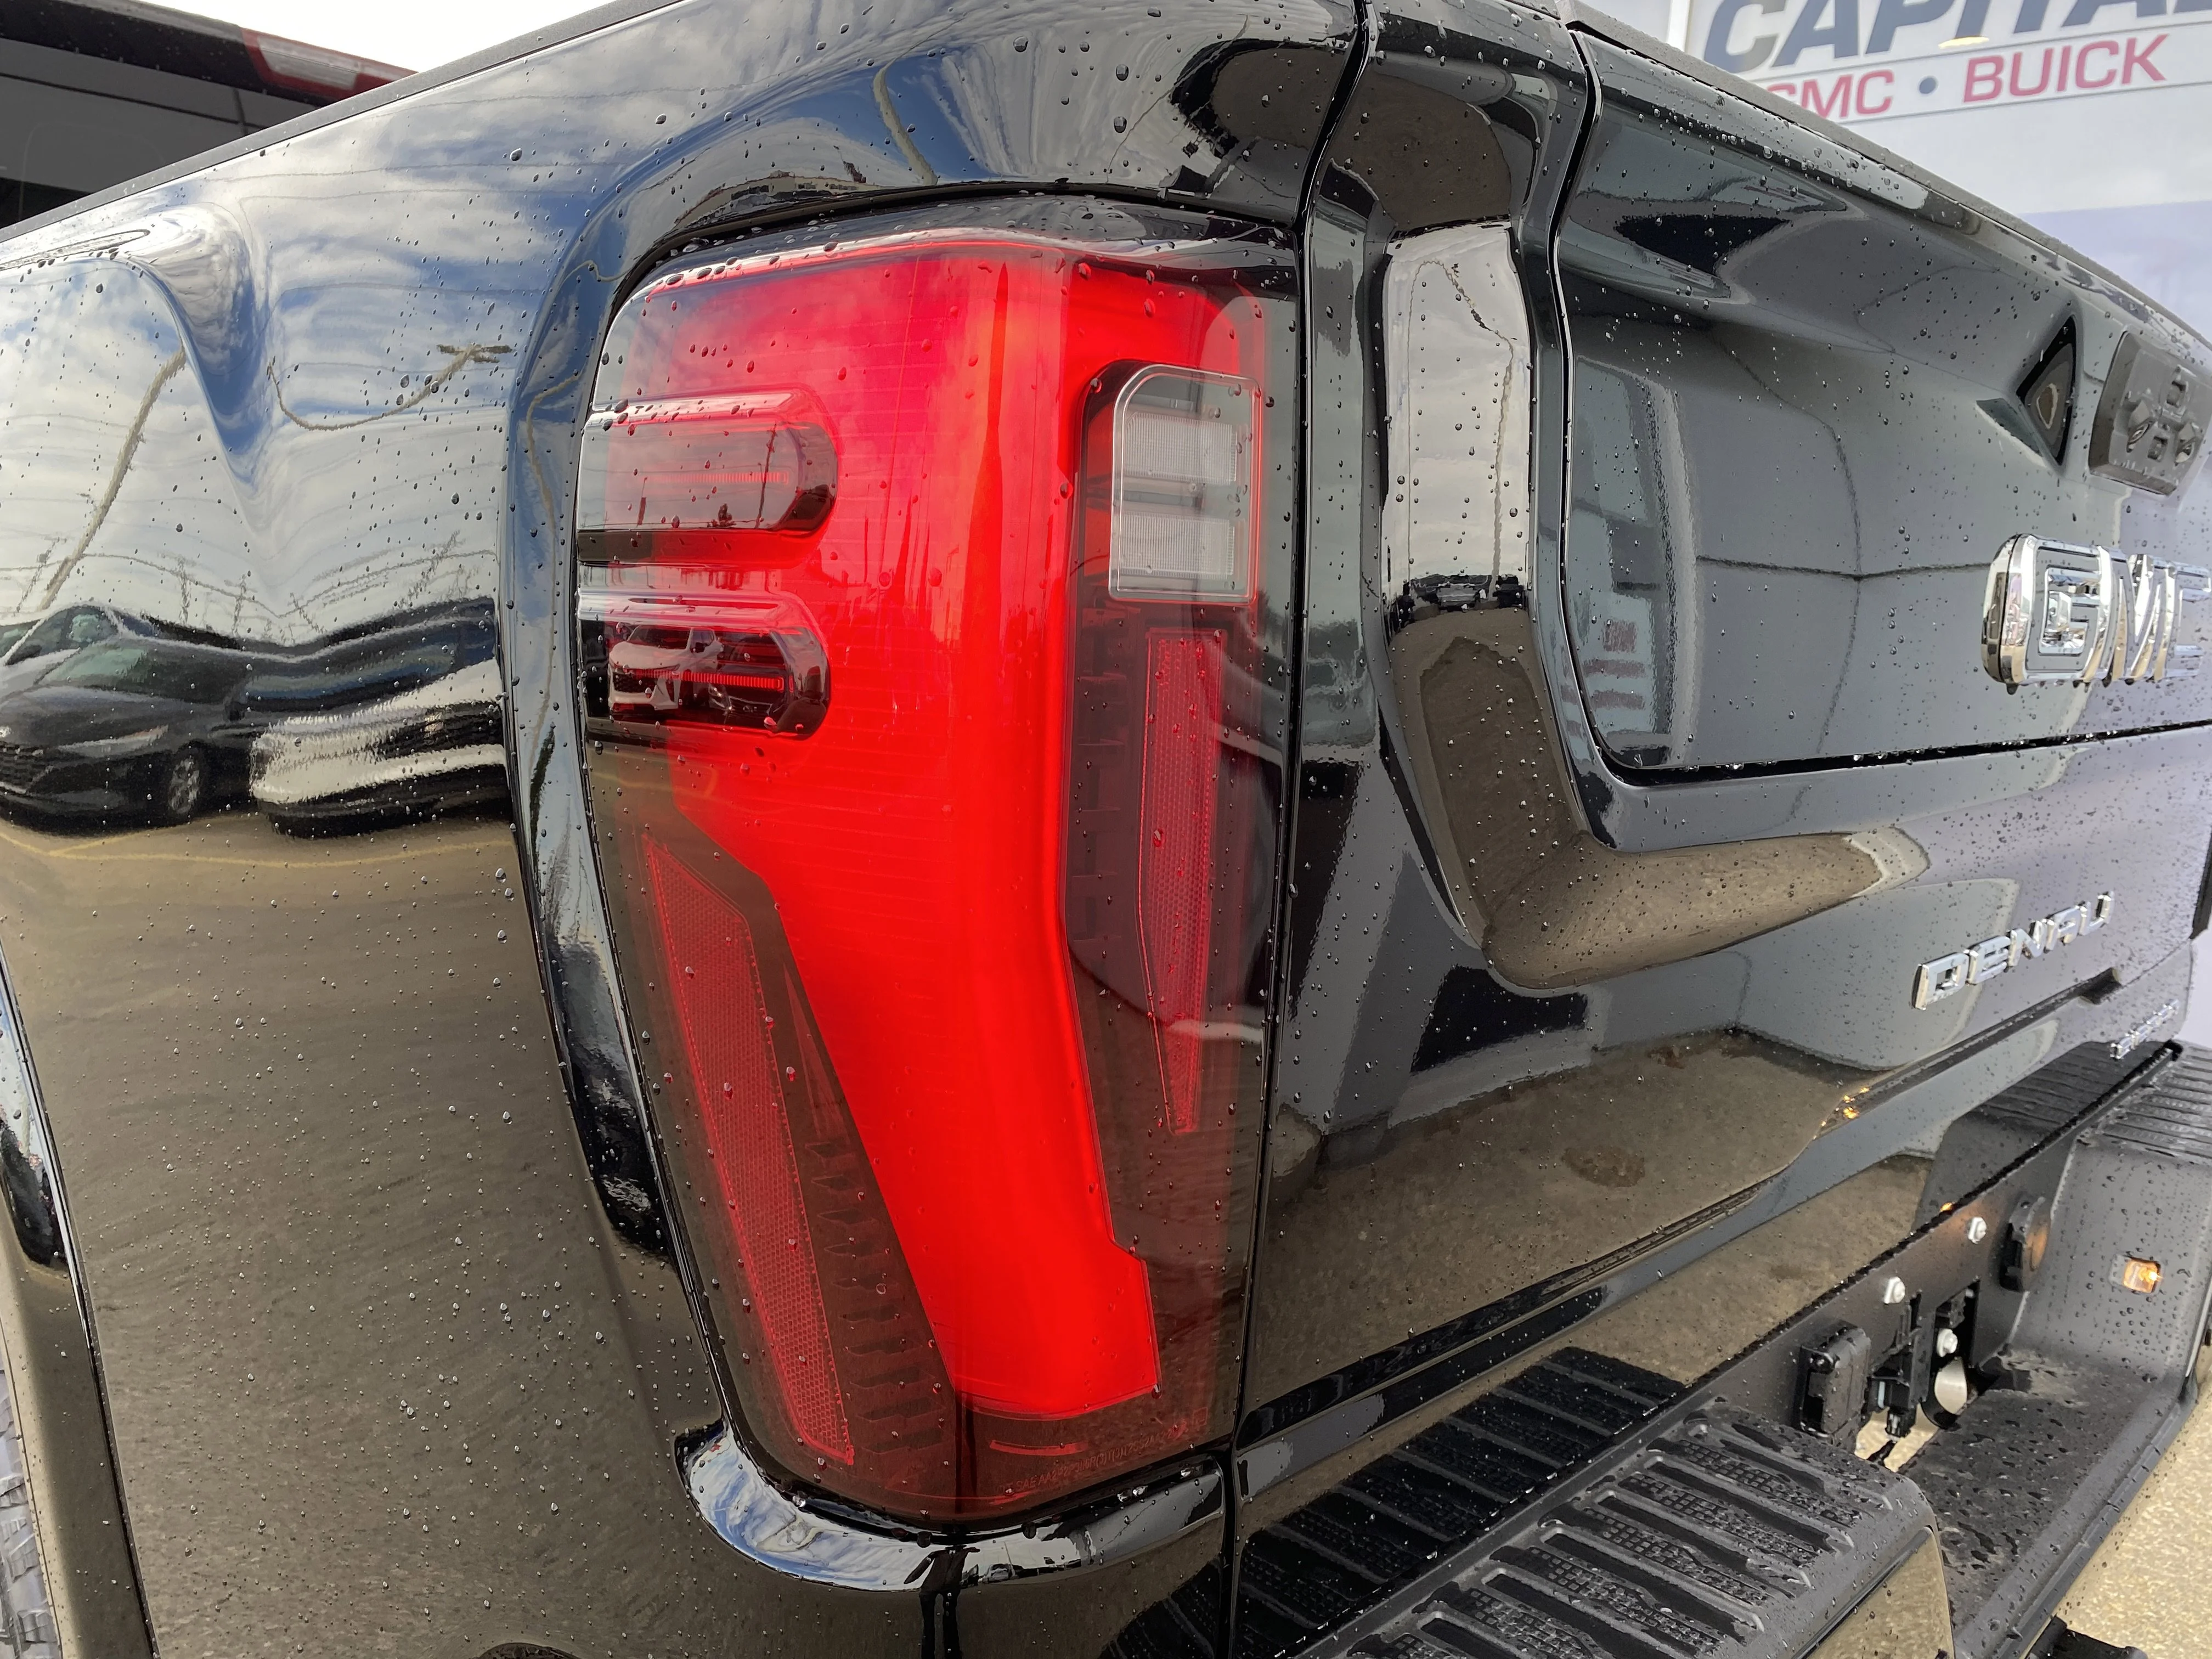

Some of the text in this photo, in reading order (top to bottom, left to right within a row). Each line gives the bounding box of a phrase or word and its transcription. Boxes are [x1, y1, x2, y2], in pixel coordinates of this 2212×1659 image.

[1703, 0, 2212, 72] CAPI
[1963, 34, 2169, 103] BUICK
[1981, 533, 2211, 684] GMC
